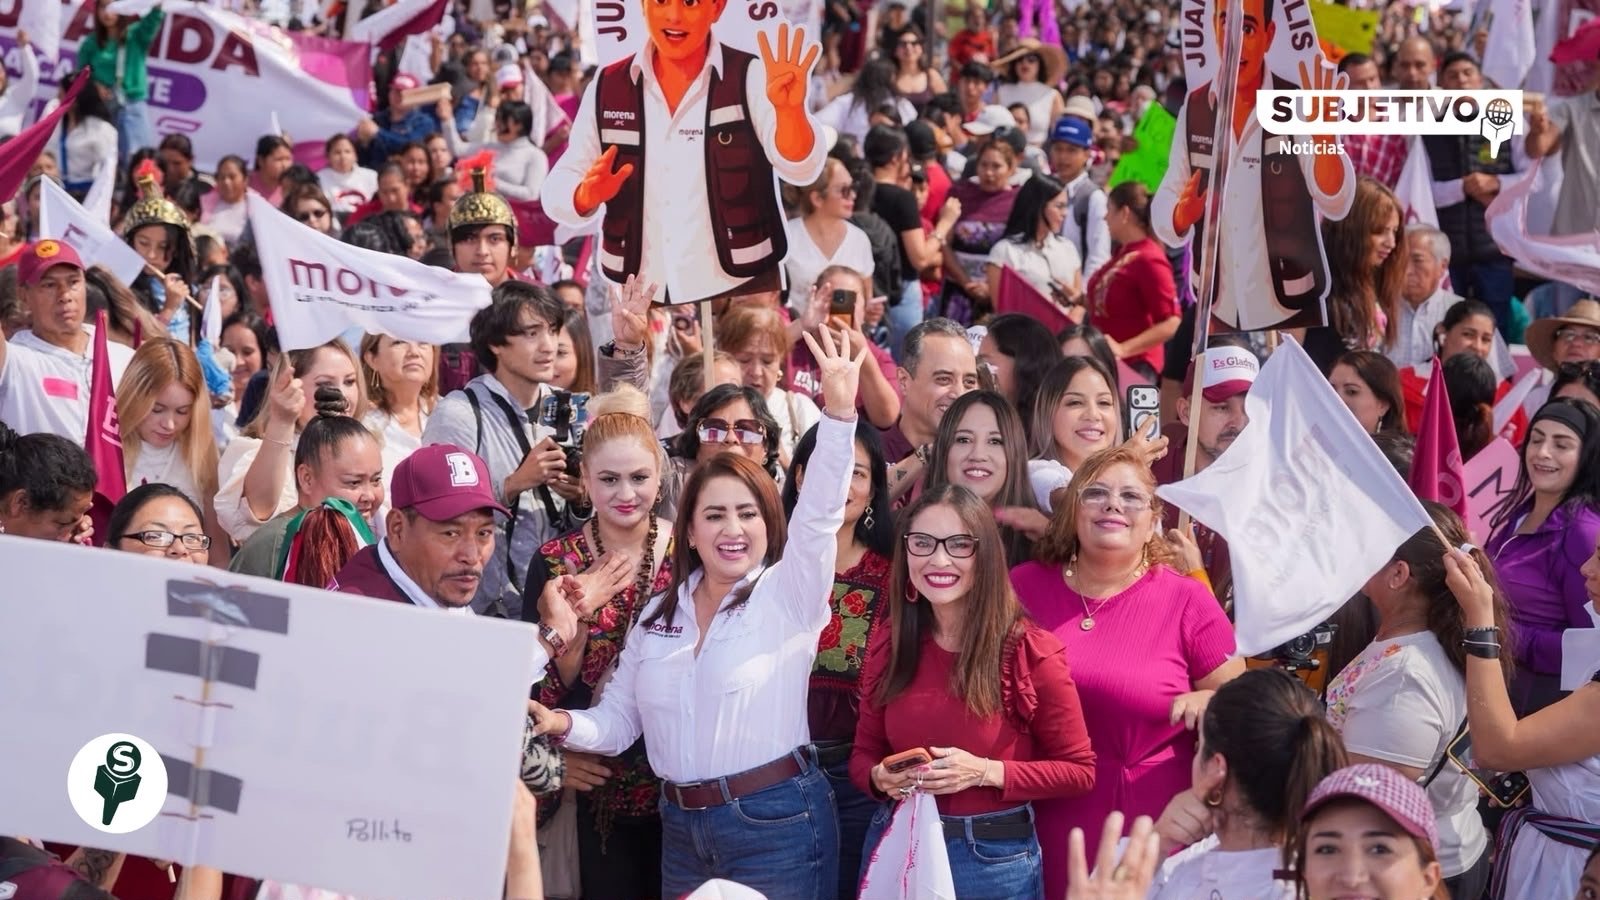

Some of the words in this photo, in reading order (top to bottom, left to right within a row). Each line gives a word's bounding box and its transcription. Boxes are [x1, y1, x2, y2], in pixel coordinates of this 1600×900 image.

[1280, 0, 1314, 51] LIS
[603, 110, 635, 120] morena
[1212, 359, 1225, 369] Es
[445, 452, 479, 487] B
